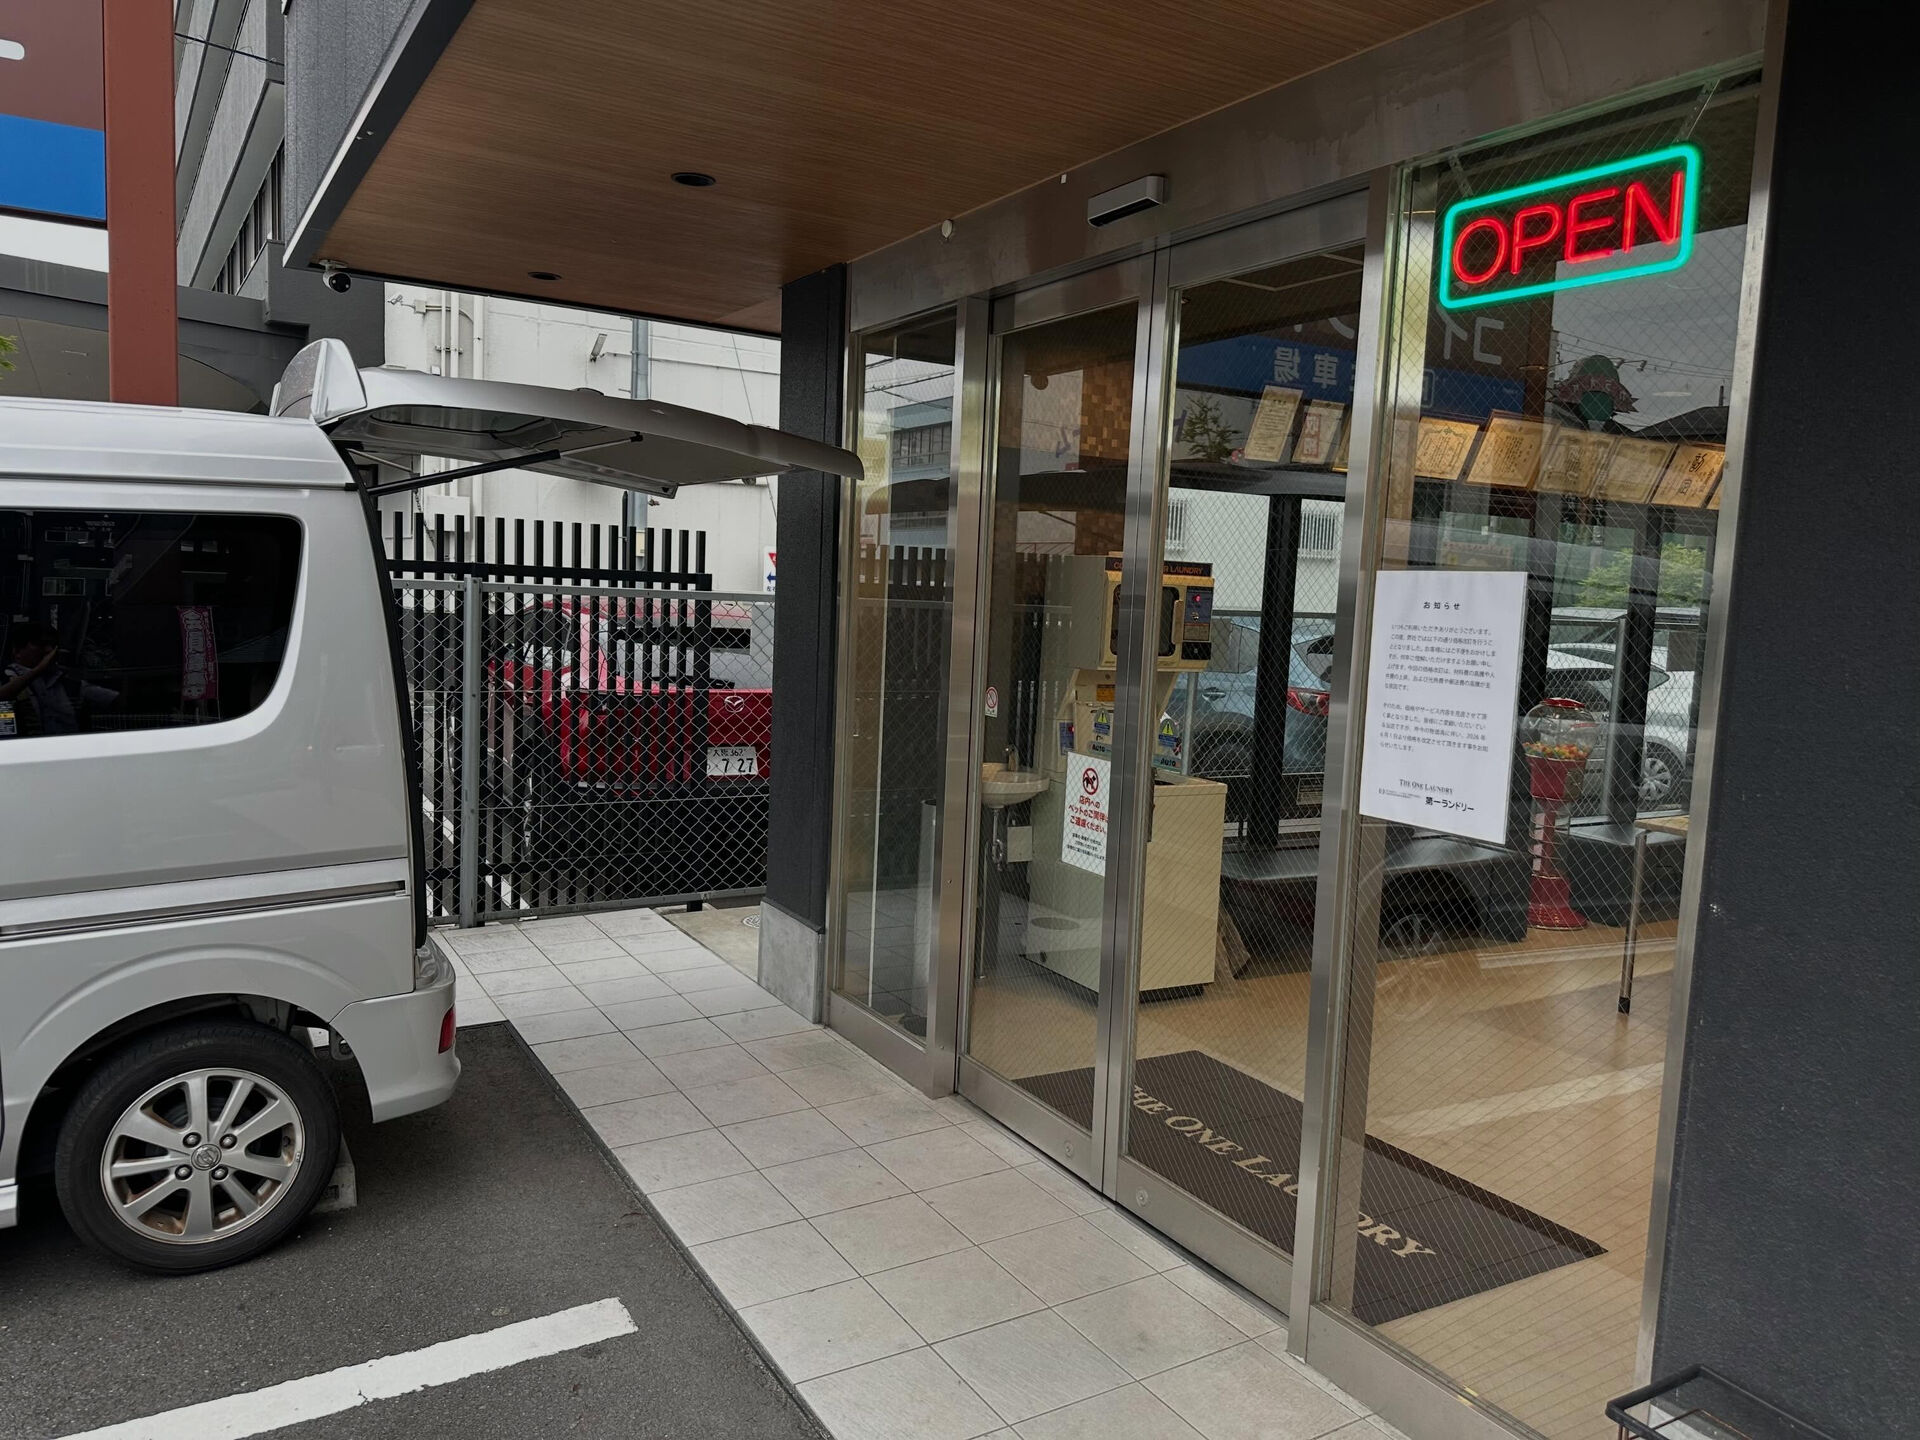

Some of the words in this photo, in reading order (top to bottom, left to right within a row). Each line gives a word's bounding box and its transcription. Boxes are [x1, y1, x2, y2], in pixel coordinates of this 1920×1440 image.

[1453, 169, 1684, 285] OPEN
[1170, 564, 1204, 575] LAUNDRY
[1423, 601, 1461, 611] お知らせ
[1424, 783, 1454, 796] LAUNDRY
[1425, 796, 1475, 812] 第一ランドリー
[1164, 1115, 1244, 1156] ONE
